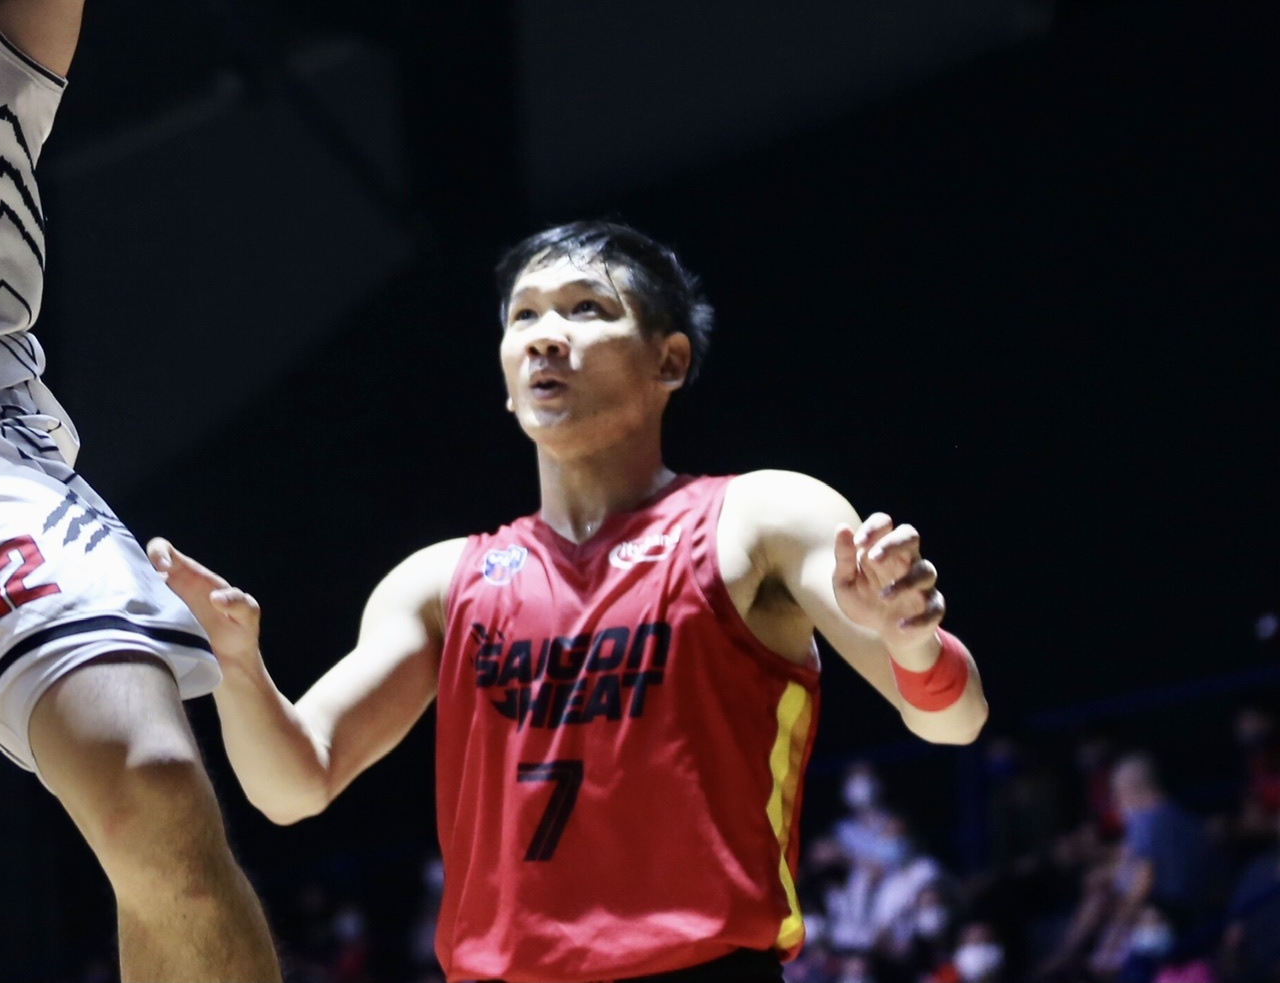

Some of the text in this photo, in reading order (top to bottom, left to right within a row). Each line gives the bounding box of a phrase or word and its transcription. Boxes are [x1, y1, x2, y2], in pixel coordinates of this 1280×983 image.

[476, 622, 672, 687] SAIGON
[512, 671, 664, 731] HEAT
[517, 760, 584, 862] 7
